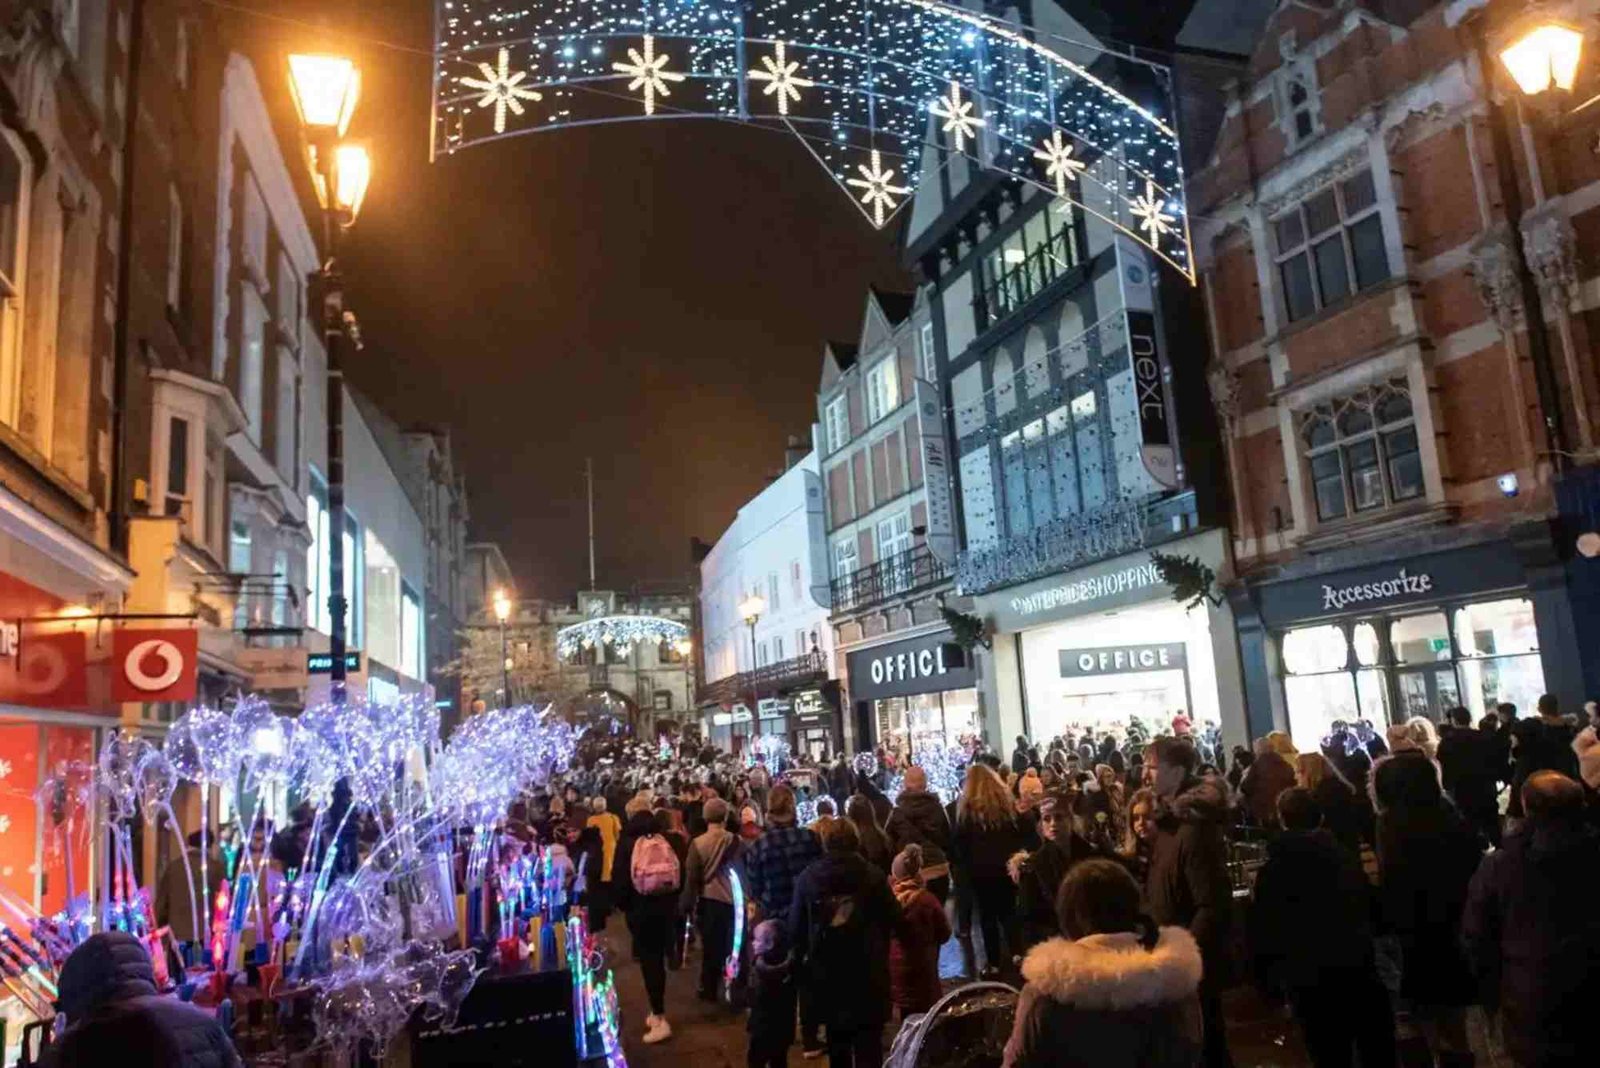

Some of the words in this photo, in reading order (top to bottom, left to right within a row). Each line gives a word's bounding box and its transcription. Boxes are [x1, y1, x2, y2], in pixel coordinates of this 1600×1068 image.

[1132, 334, 1163, 420] next
[1321, 568, 1432, 610] Accessorize
[1078, 650, 1170, 673] OFFICE
